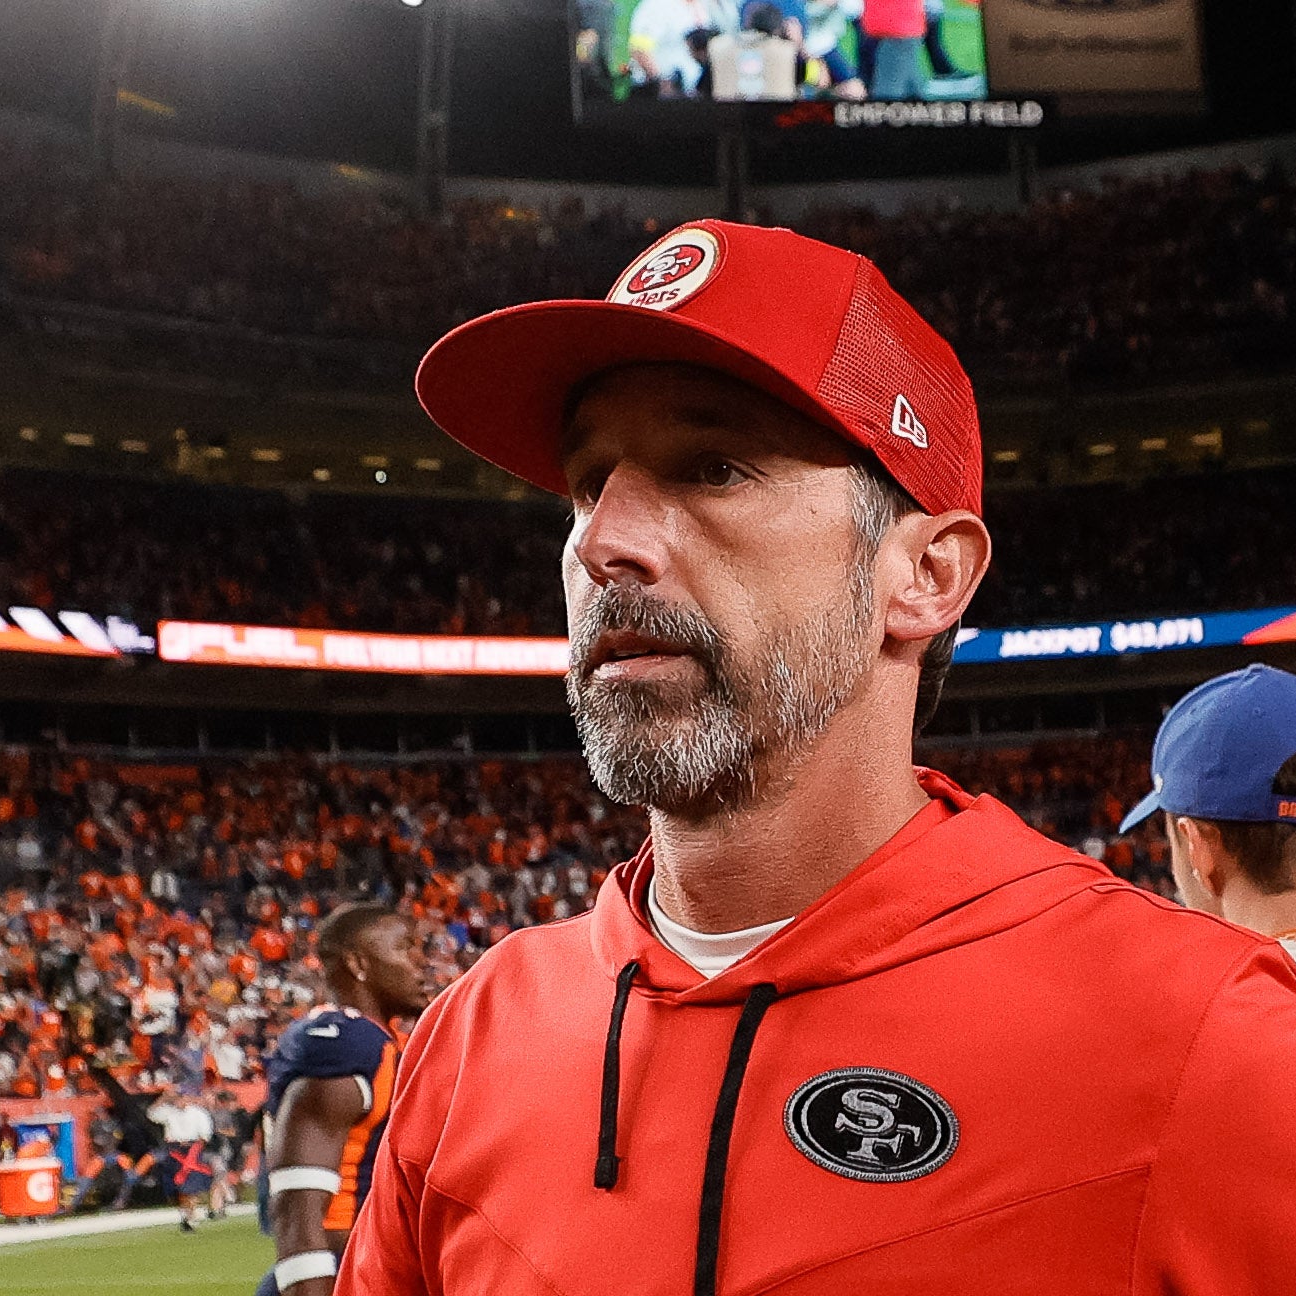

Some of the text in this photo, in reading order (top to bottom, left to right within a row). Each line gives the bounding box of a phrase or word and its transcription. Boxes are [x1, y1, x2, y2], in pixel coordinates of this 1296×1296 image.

[834, 100, 1044, 127] EMPOWER FIELD
[628, 287, 681, 307] 9ers
[999, 626, 1102, 658] JACKPOT
